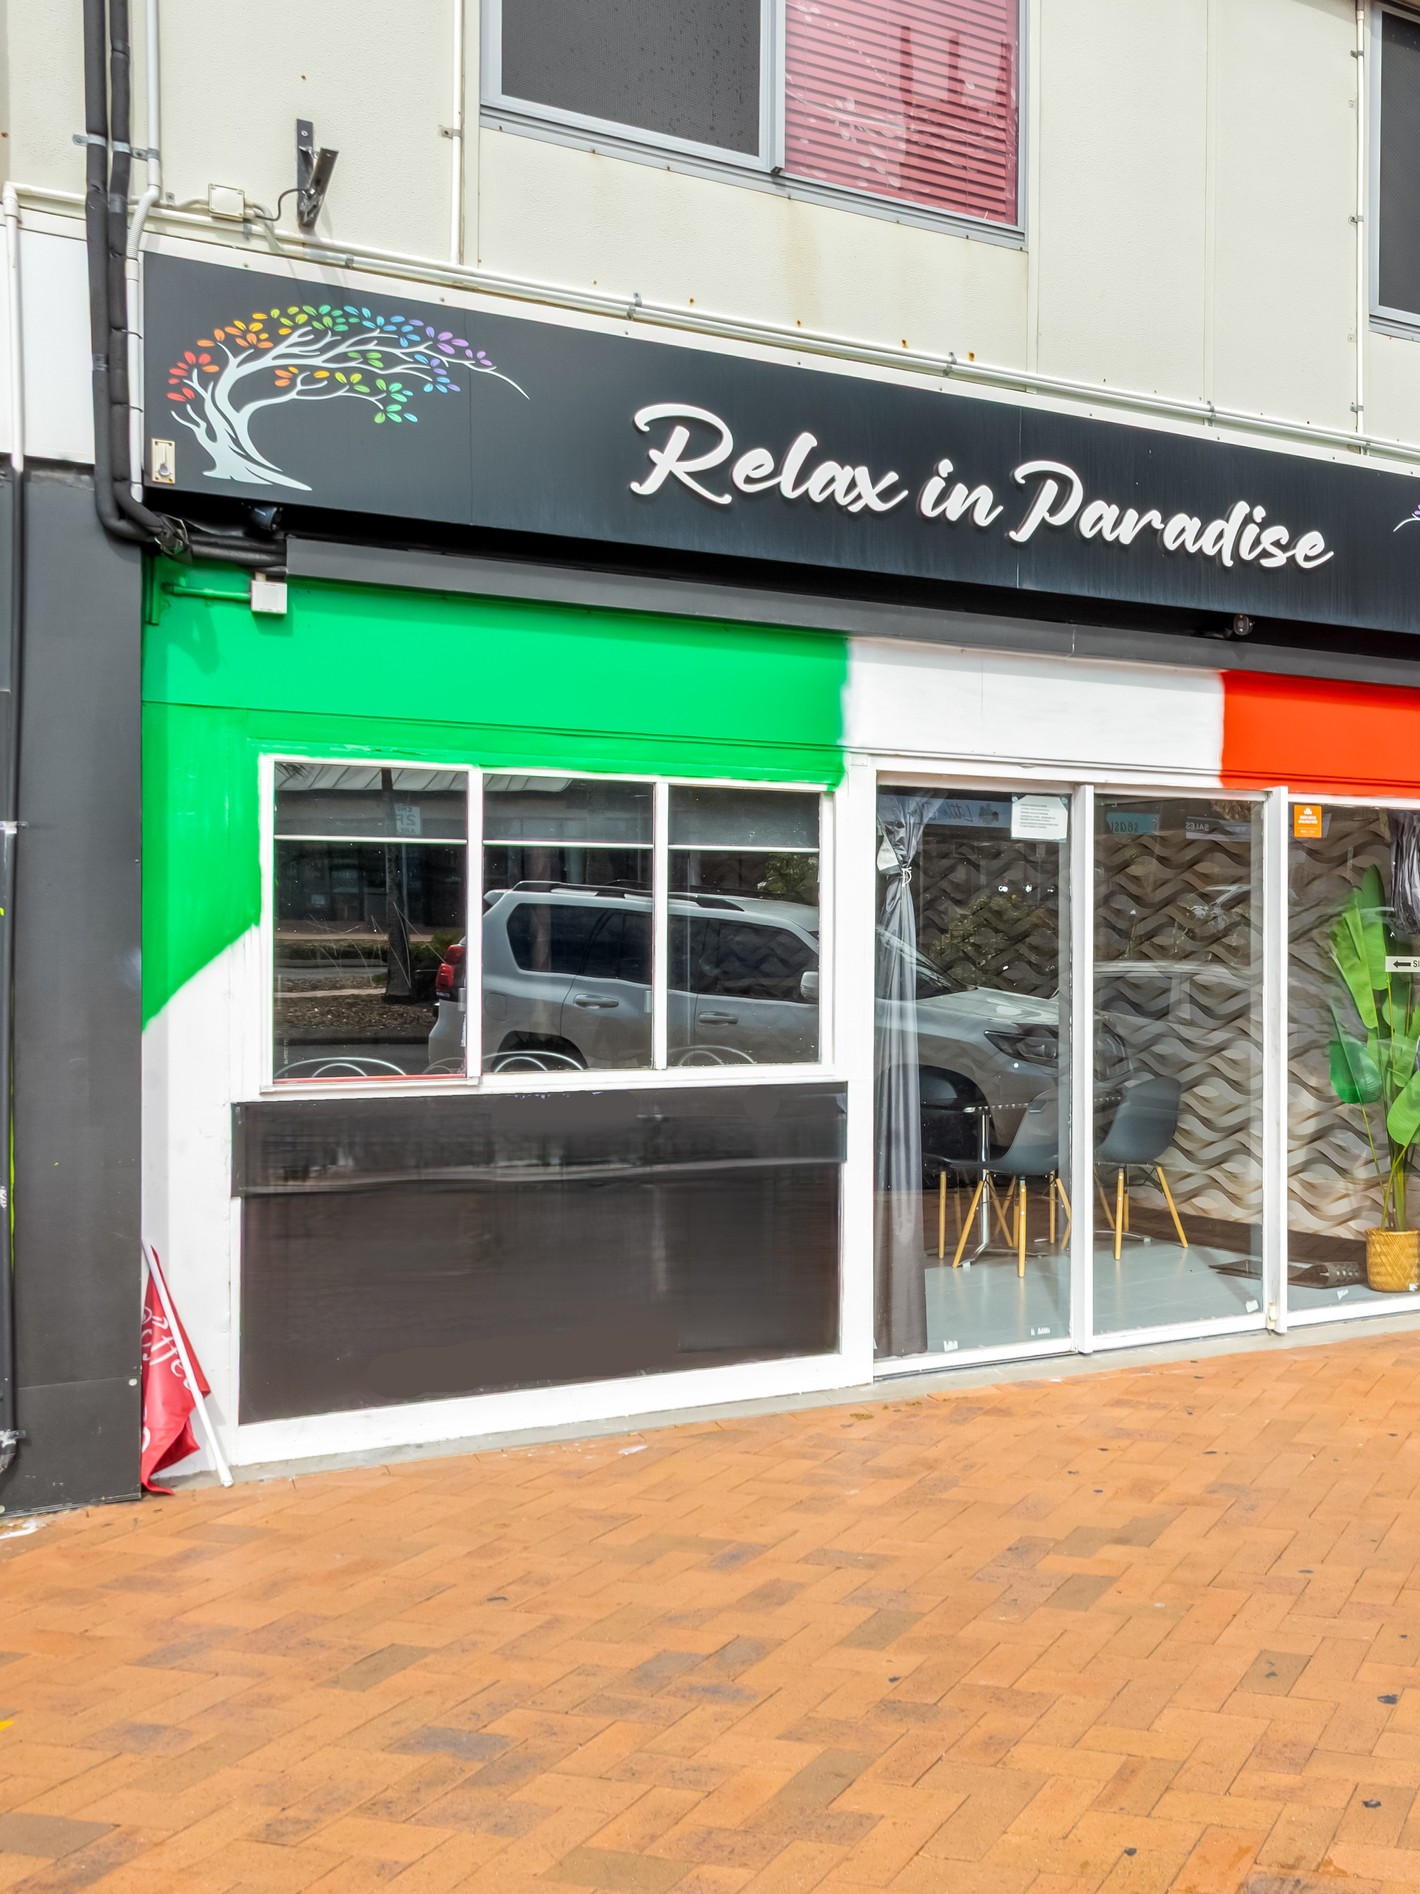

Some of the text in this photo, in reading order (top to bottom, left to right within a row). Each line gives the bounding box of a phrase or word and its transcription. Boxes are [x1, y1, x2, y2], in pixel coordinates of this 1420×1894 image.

[630, 403, 1335, 570] Relax in Paradise
